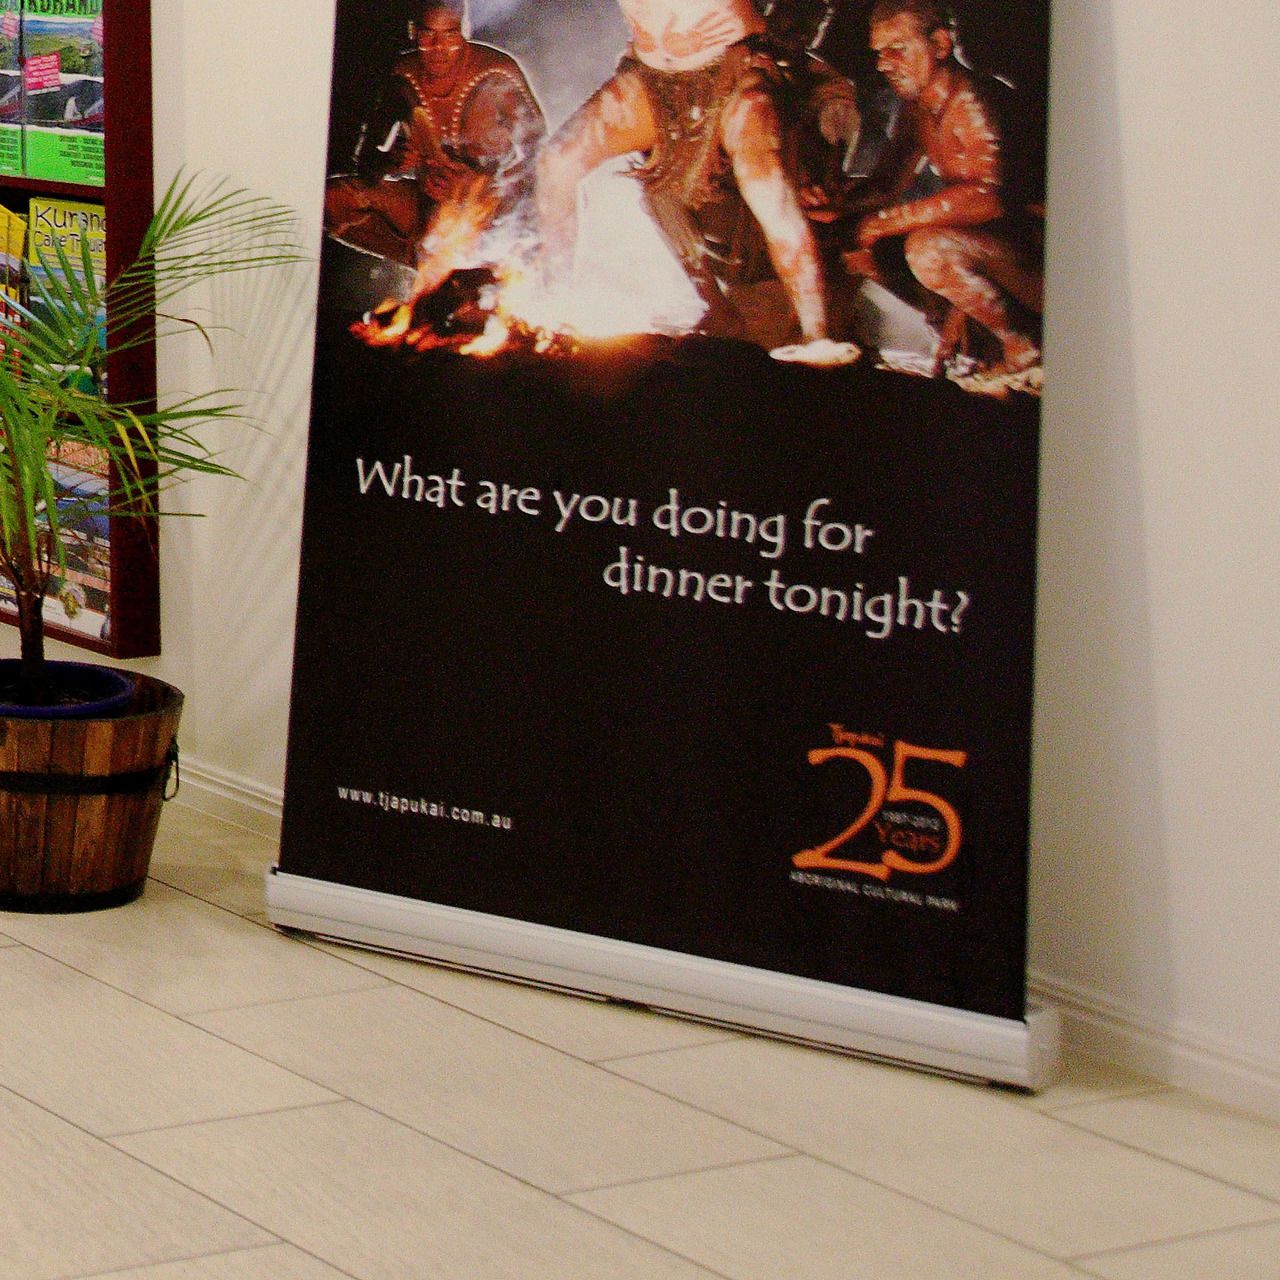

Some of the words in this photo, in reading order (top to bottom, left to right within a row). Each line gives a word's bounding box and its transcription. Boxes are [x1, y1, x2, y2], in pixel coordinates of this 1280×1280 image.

[34, 230, 67, 249] Cae
[355, 455, 465, 509] What
[476, 476, 540, 517] are
[553, 489, 639, 532] you
[652, 488, 787, 558] doing
[803, 498, 875, 554] for
[602, 546, 752, 606] dinner
[763, 570, 970, 639] tonight?
[337, 786, 513, 830] www.tjapukai.com.au
[791, 739, 968, 882] 25
